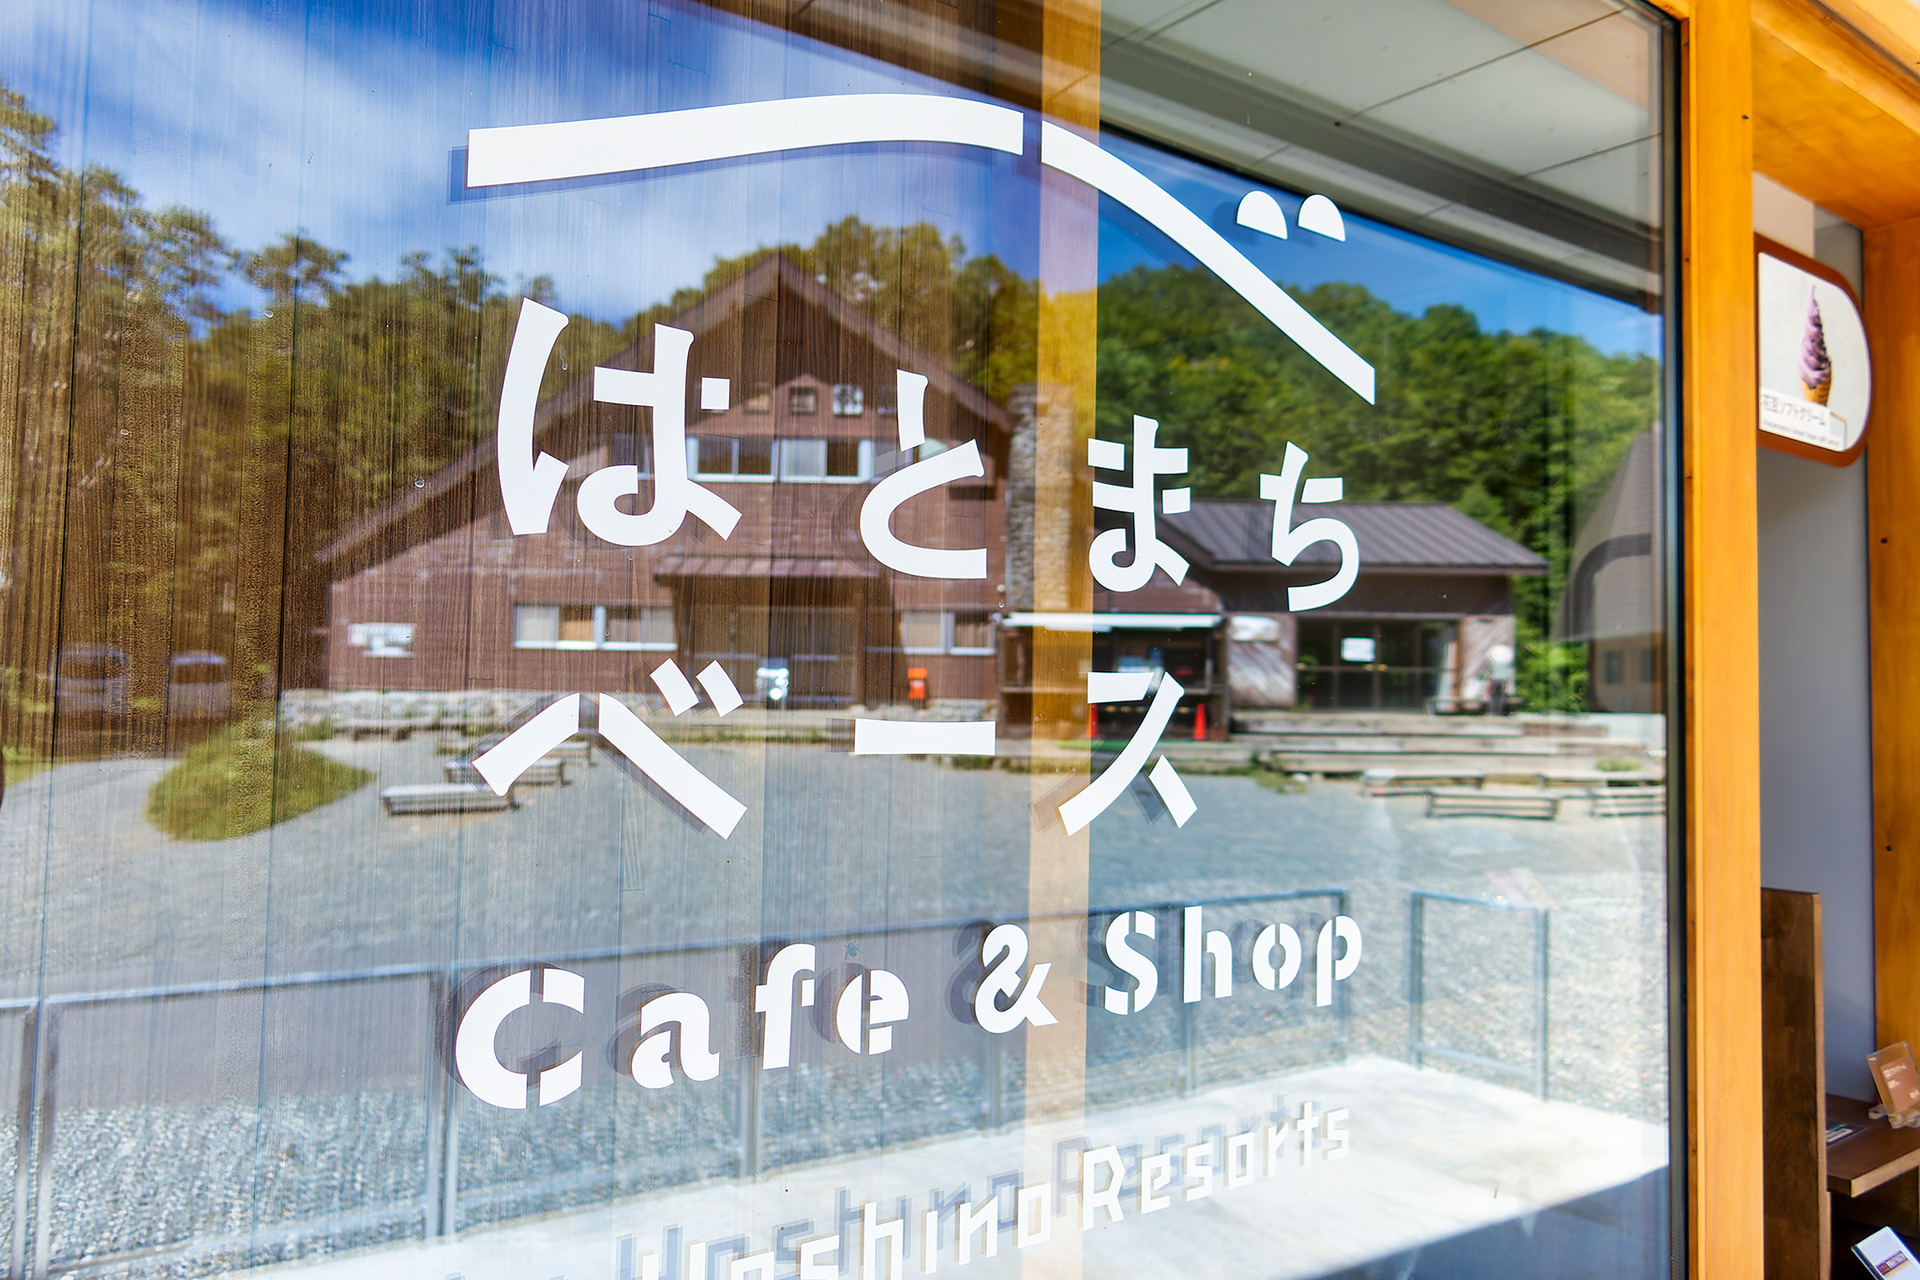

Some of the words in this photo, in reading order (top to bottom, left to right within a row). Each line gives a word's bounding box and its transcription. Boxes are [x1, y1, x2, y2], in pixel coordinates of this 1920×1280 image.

[497, 297, 1360, 611] はとまち
[471, 658, 1198, 840] ベース
[455, 943, 909, 1109] Cafe
[975, 924, 1059, 1034] &
[1105, 906, 1363, 1016] Shop
[1083, 1100, 1350, 1231] Resorts
